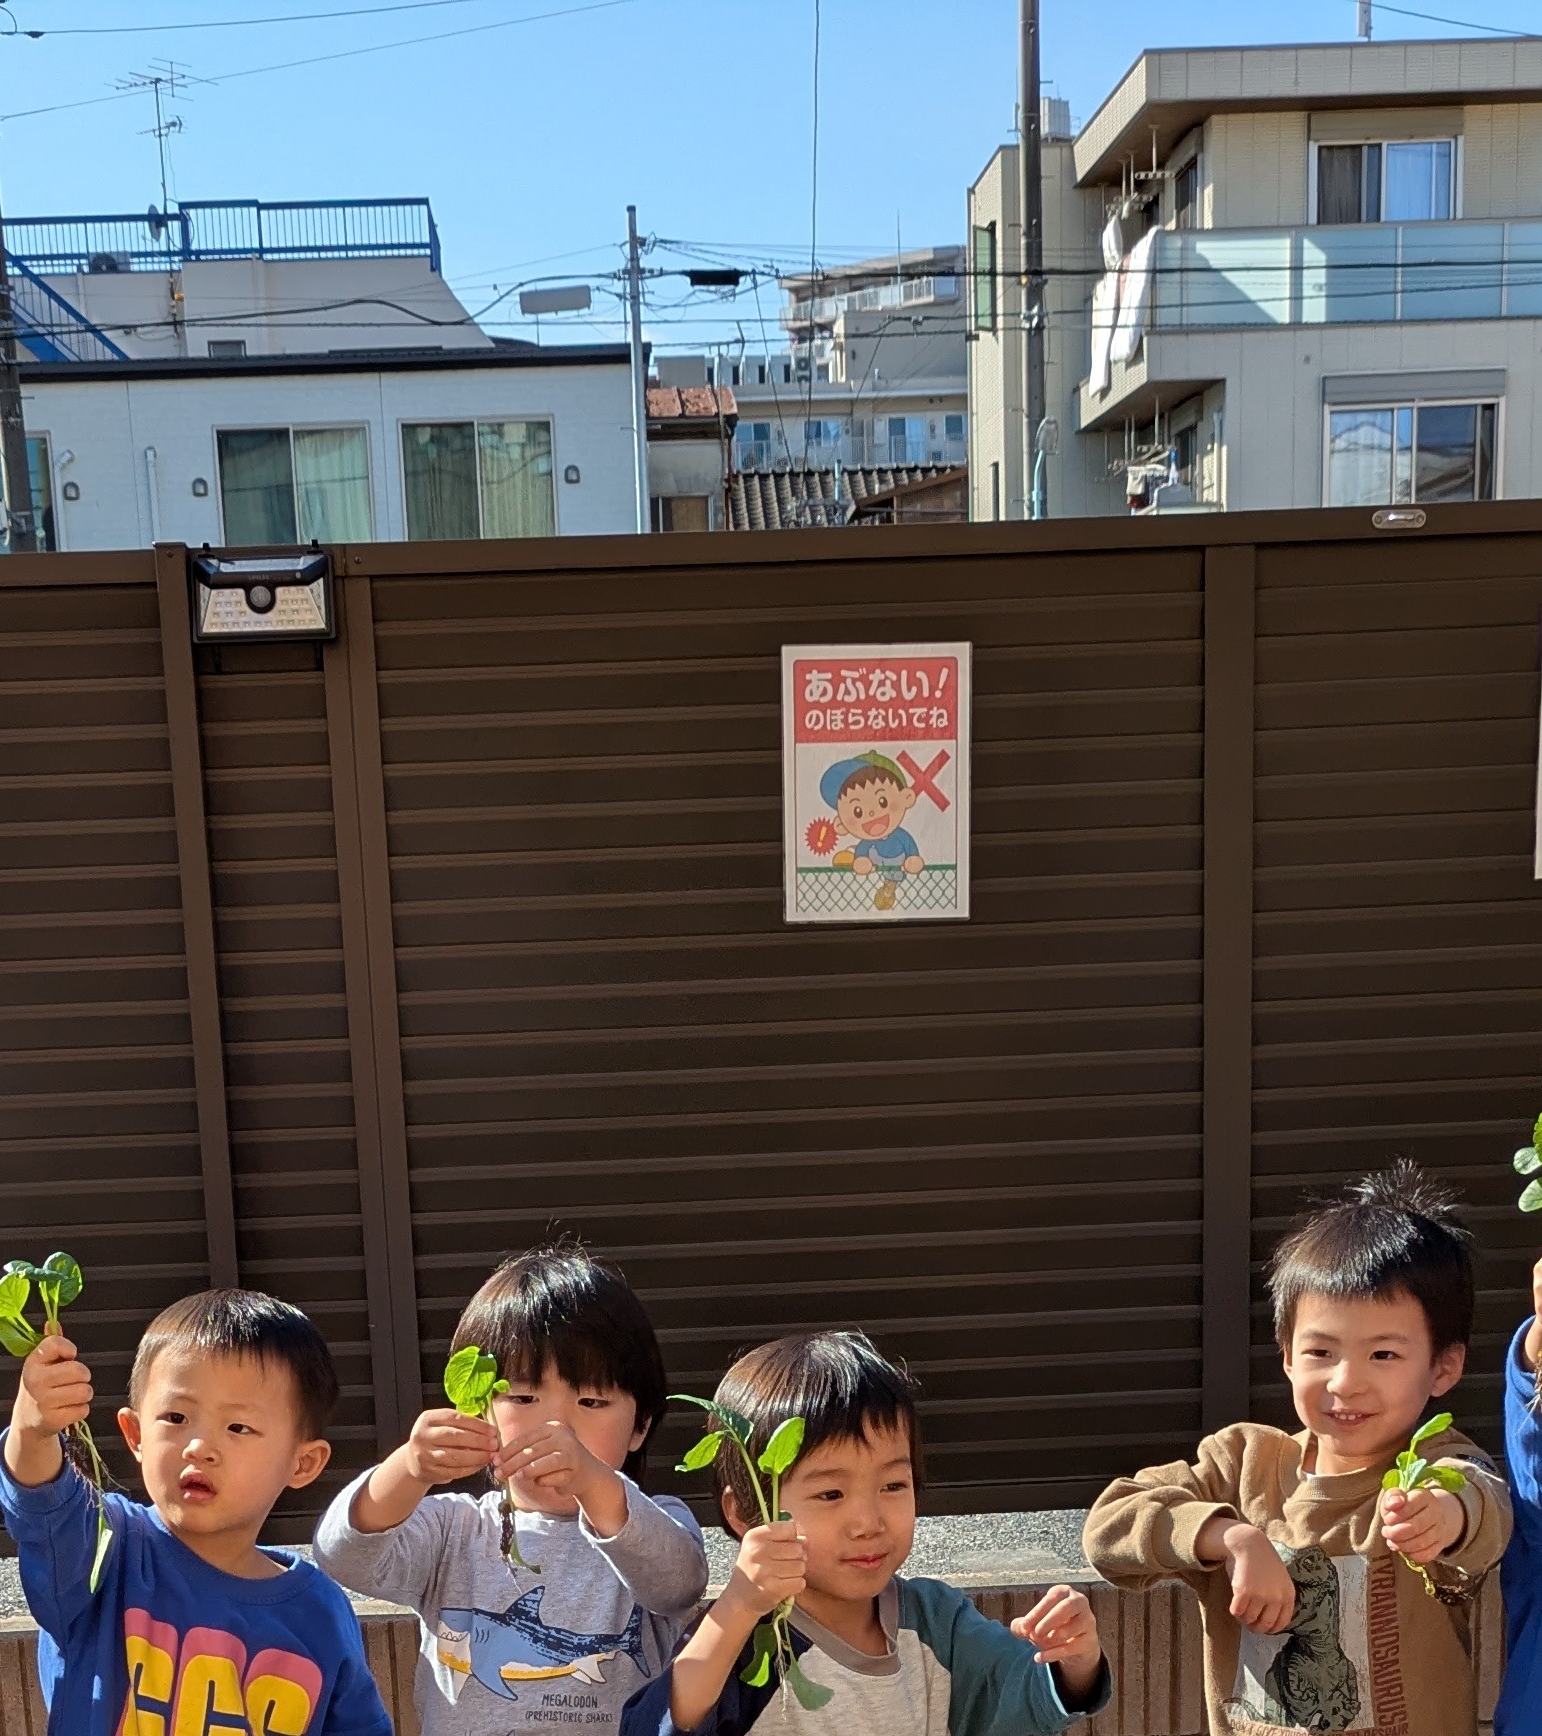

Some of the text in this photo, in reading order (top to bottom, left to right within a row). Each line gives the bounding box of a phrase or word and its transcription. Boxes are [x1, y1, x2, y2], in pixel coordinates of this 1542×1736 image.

[804, 667, 949, 703] あぶない!
[804, 706, 949, 731] のぼらないでね
[1370, 1551, 1407, 1727] TYRANNOSAURUS
[541, 1694, 598, 1708] MEGALODON
[525, 1711, 613, 1723] (PREHISTORIC SHARK)
